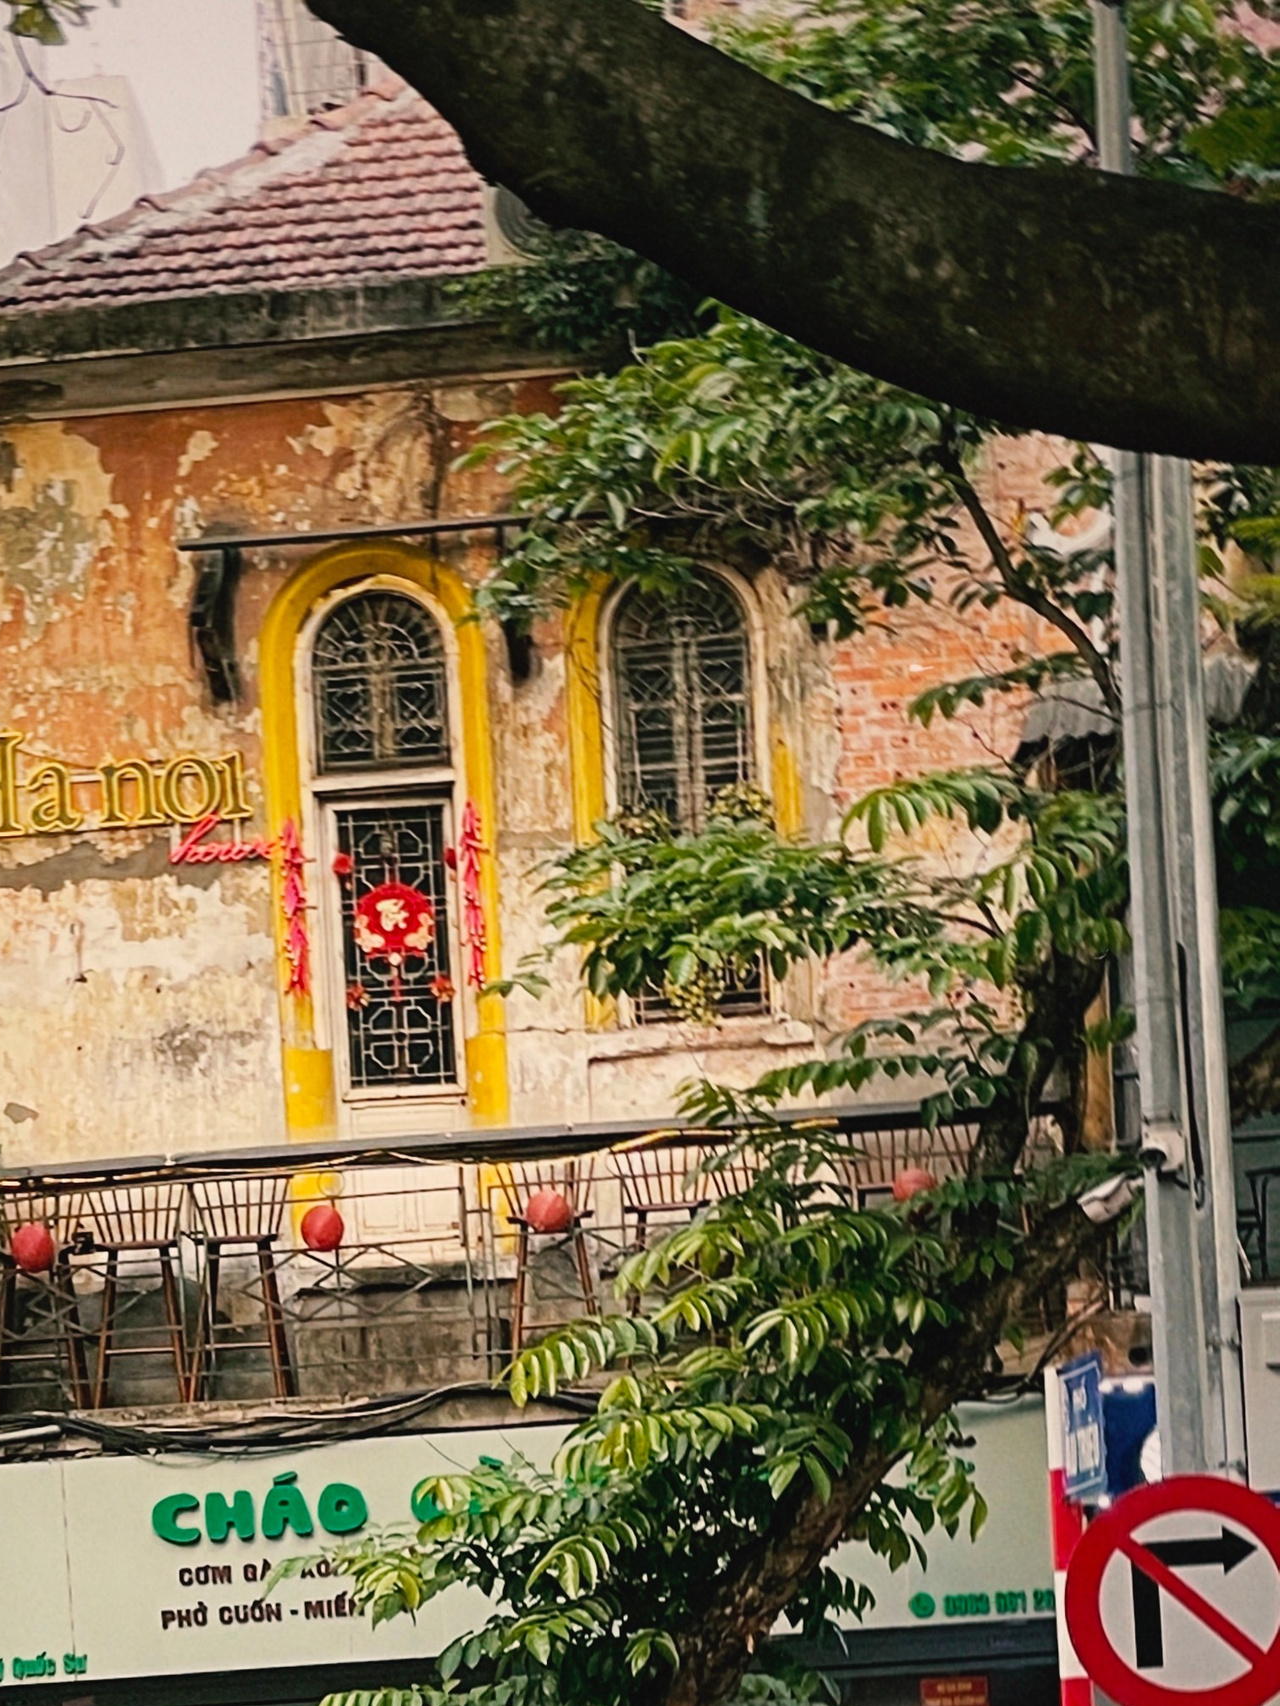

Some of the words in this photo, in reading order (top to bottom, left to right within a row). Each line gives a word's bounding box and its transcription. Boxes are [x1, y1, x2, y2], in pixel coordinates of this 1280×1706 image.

[152, 1471, 368, 1546] CHÁO
[178, 1562, 232, 1587] CƠM
[161, 1601, 208, 1631] PHỞ
[219, 1597, 282, 1625] CUỐN
